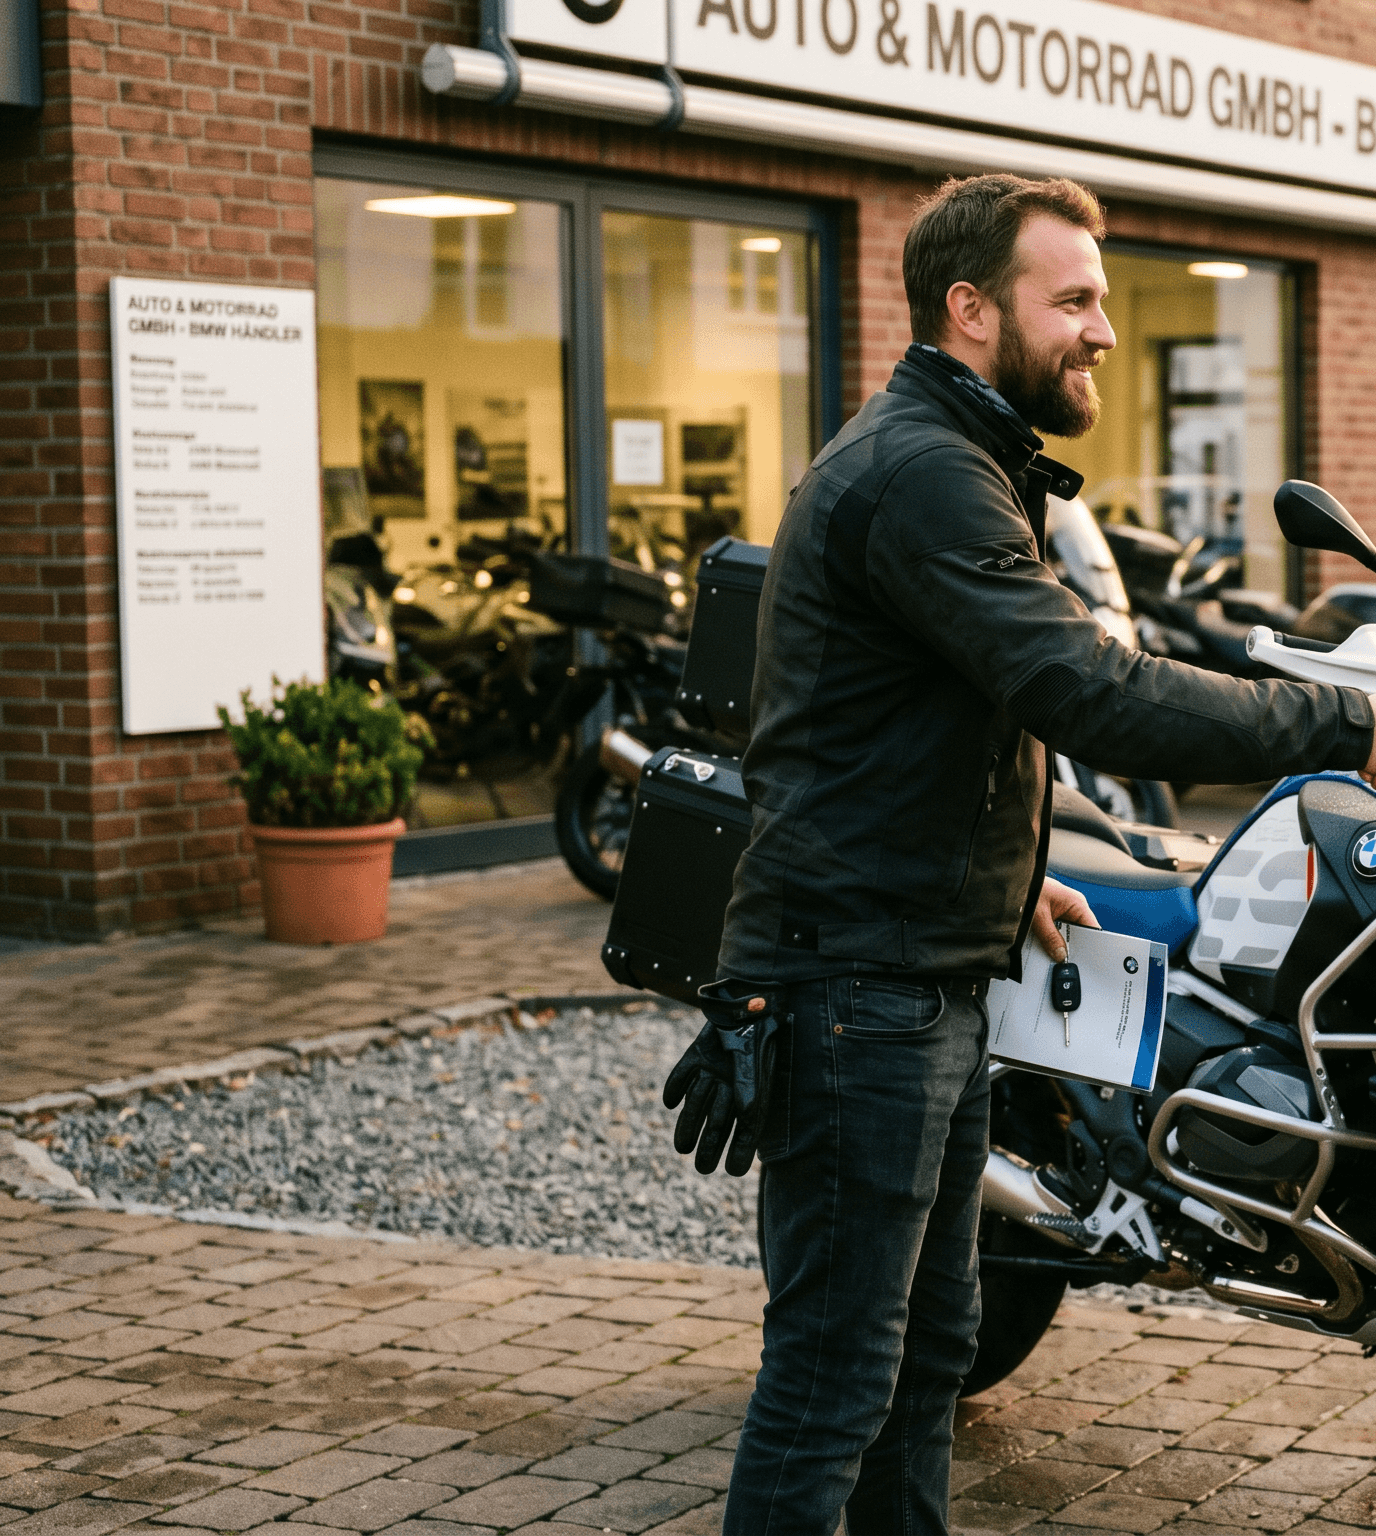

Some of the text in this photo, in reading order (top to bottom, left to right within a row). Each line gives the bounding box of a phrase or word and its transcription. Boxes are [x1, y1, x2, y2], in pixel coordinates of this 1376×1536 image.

[876, 0, 909, 67] &
[926, 3, 1193, 118] MOTORRAD
[1208, 65, 1320, 146] GMBH
[128, 295, 278, 319] AUTO & MOTORRAD
[128, 318, 175, 335] GMBH
[190, 322, 226, 338] BMW
